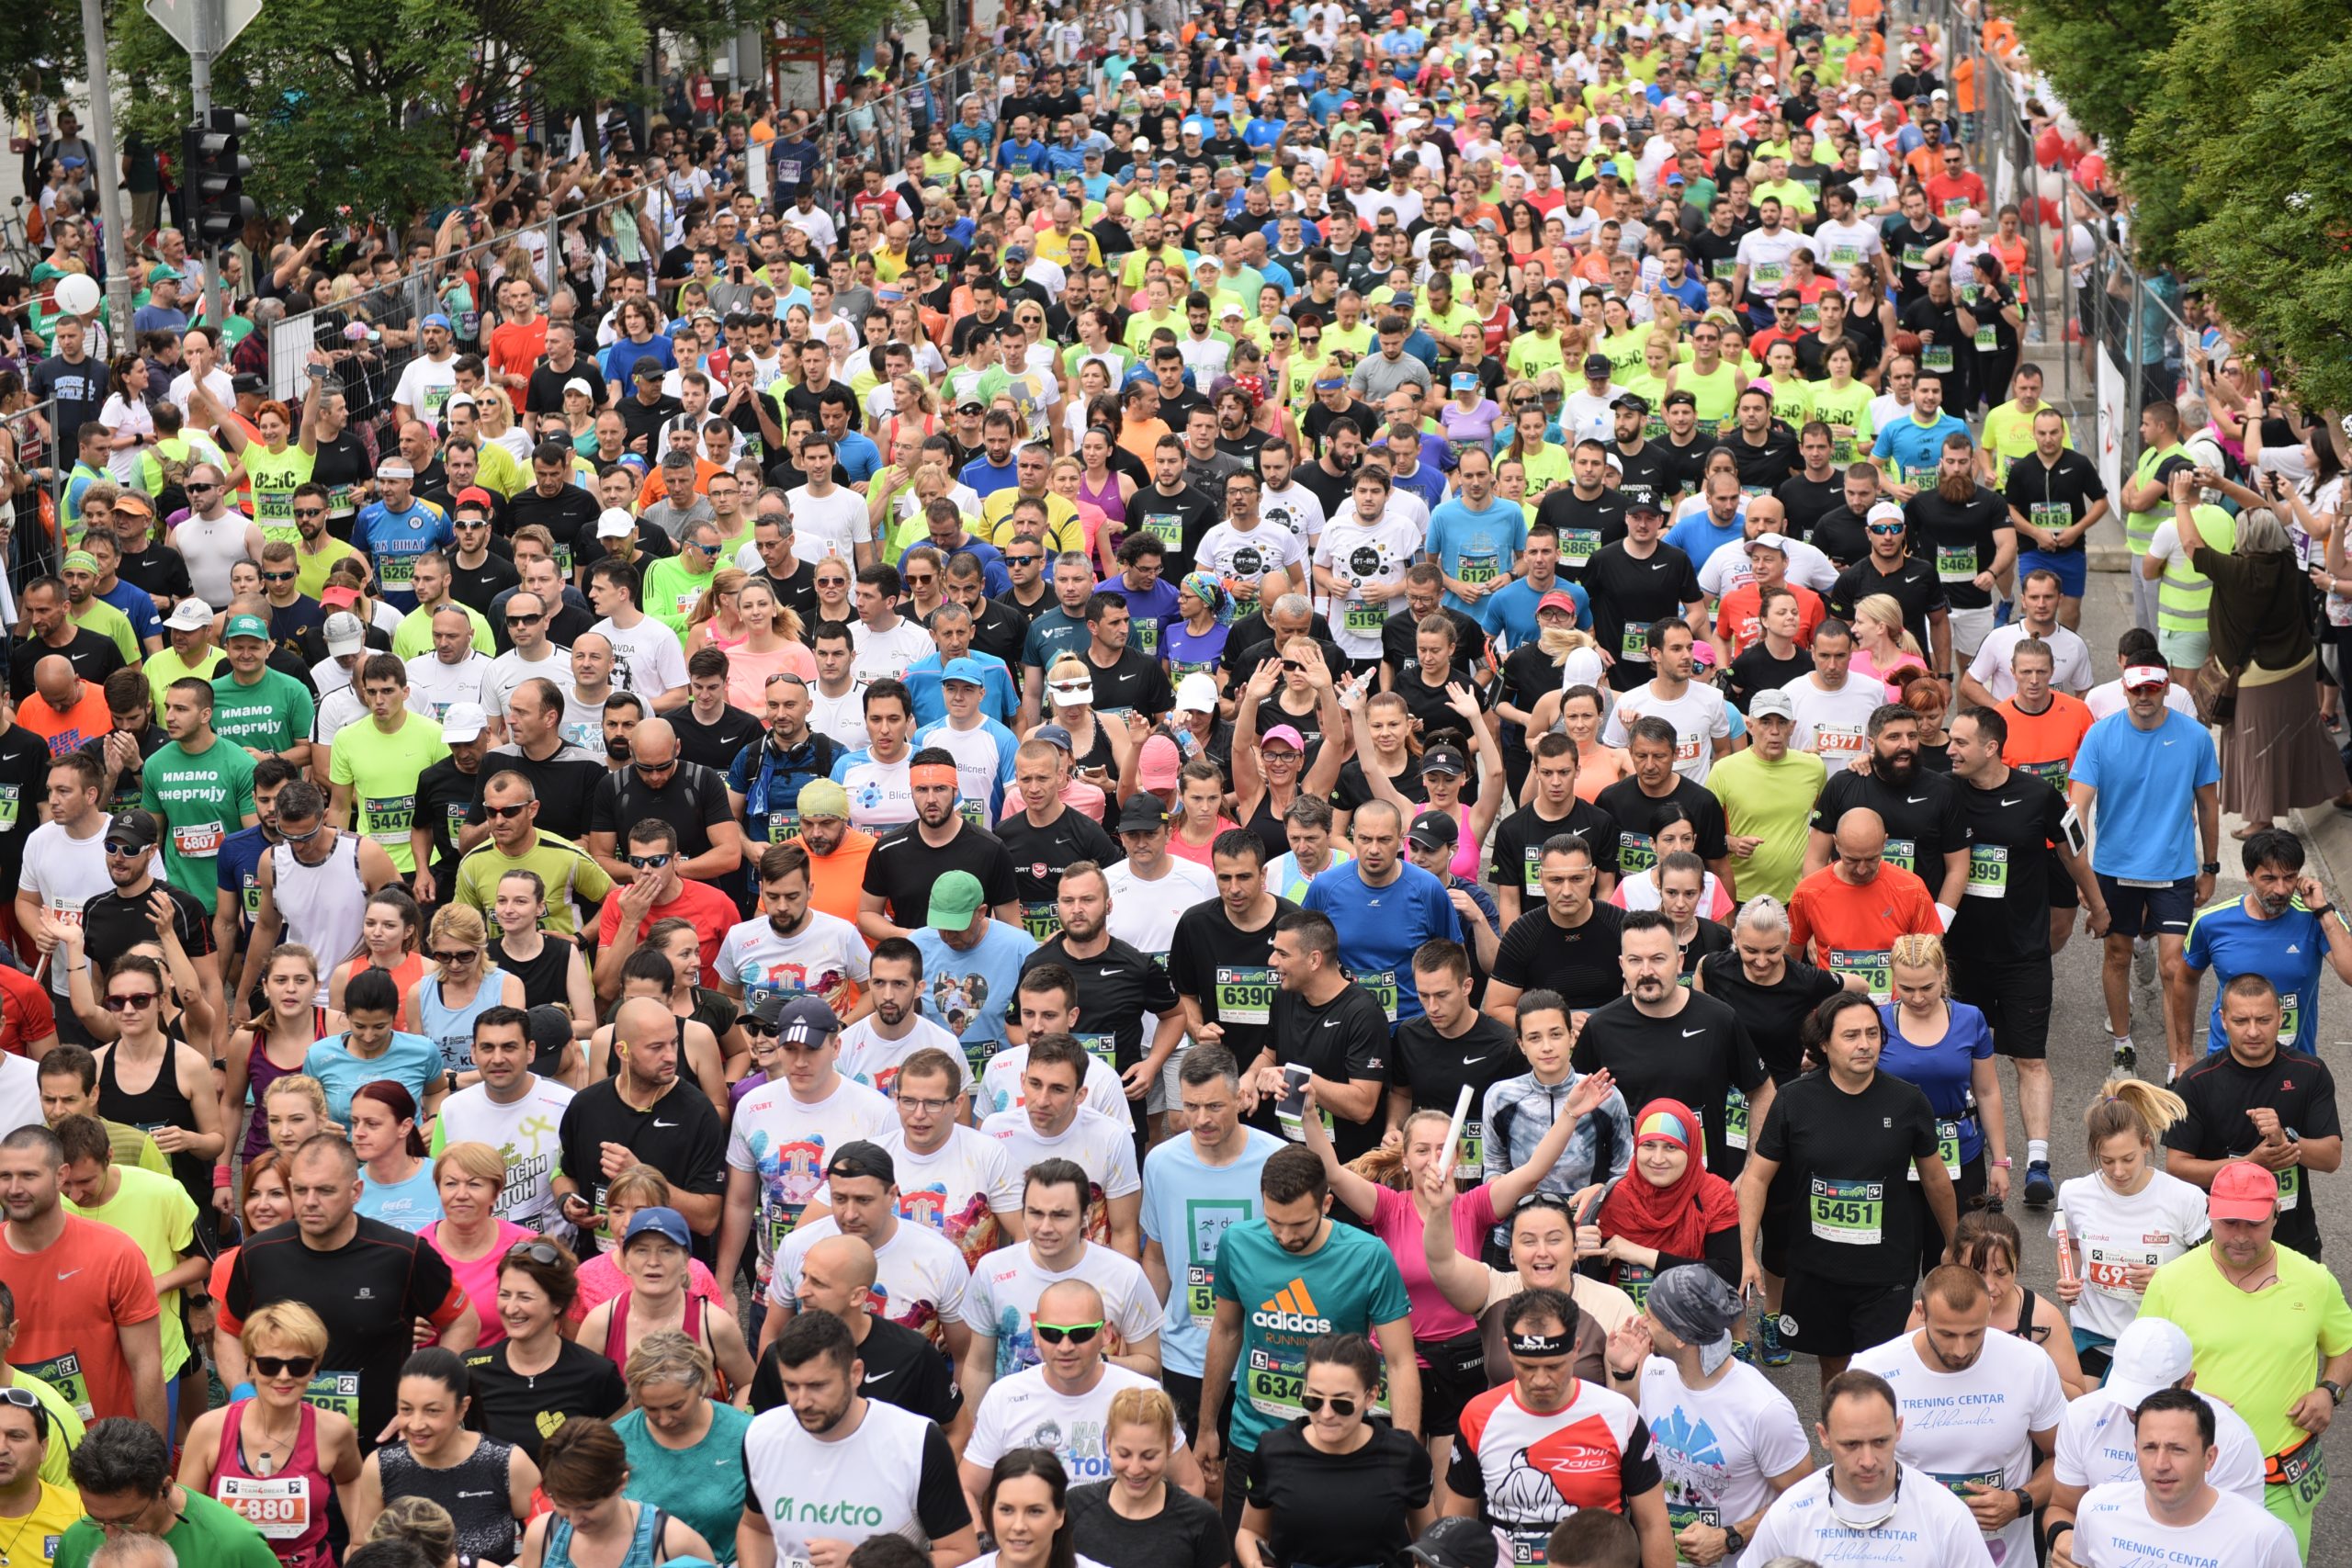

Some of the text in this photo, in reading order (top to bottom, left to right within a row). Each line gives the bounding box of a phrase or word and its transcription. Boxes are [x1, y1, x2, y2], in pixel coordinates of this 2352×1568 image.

[2034, 513, 2067, 526] 6145
[1562, 542, 1598, 555] 5865
[1237, 557, 1260, 566] RT-RK
[1353, 558, 1376, 567] RT-RK
[1940, 558, 1973, 572] 5462
[383, 567, 414, 581] 5262
[1462, 569, 1497, 582] 6120
[1348, 612, 1385, 626] 5194
[221, 705, 273, 720] имамо
[216, 717, 282, 739] енергију
[1820, 736, 1858, 749] 6877
[956, 763, 987, 775] Blicnet
[162, 771, 220, 786] имамо
[158, 785, 232, 804] енергију
[370, 811, 414, 830] 5447
[182, 836, 217, 852] 6807
[1223, 985, 1273, 1008] 6390
[1818, 1202, 1873, 1222] 5451
[1252, 1311, 1332, 1334] adidas
[1265, 1331, 1314, 1347] RUNNIN
[1902, 1393, 2006, 1410] TRENING CENTAR
[799, 1499, 884, 1527] nestro
[1815, 1528, 1919, 1547] TRENING CENTAR
[2110, 1537, 2219, 1568] TRENING CENTAR
